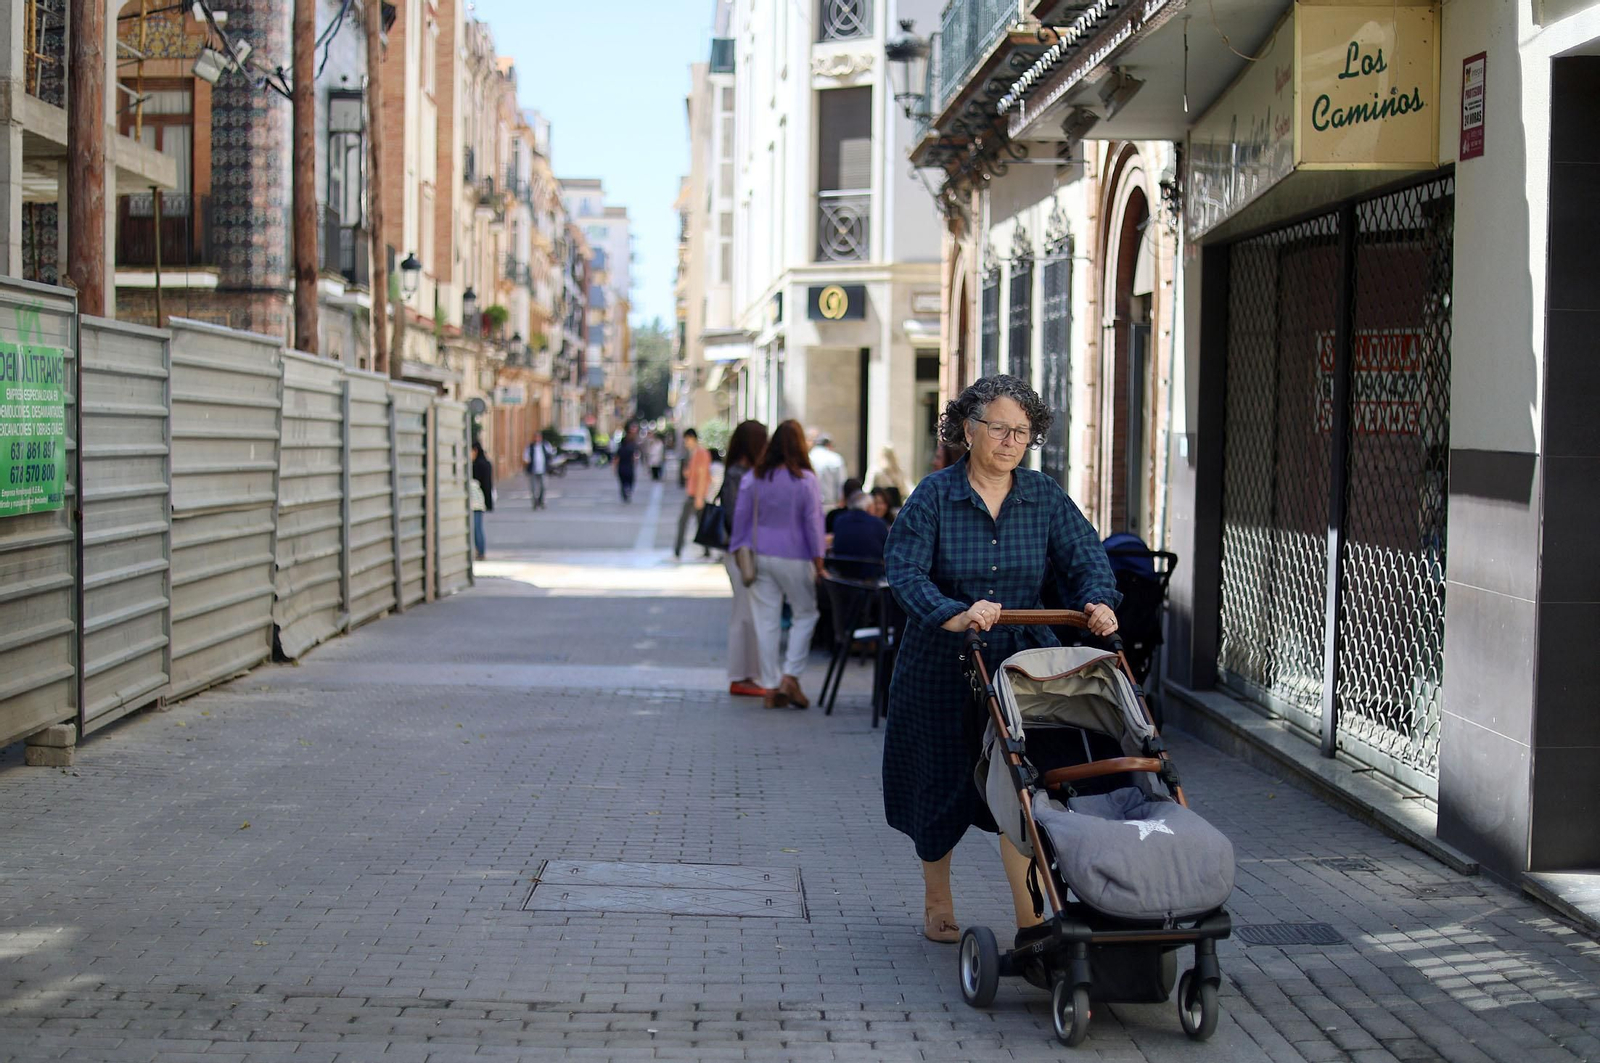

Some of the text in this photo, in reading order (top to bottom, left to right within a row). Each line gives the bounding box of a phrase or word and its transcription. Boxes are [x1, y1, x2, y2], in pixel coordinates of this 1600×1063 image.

[1338, 40, 1388, 80] Los
[1311, 86, 1424, 132] Caminos
[11, 440, 56, 460] 637 861 897
[10, 463, 56, 484] 678 570 800
